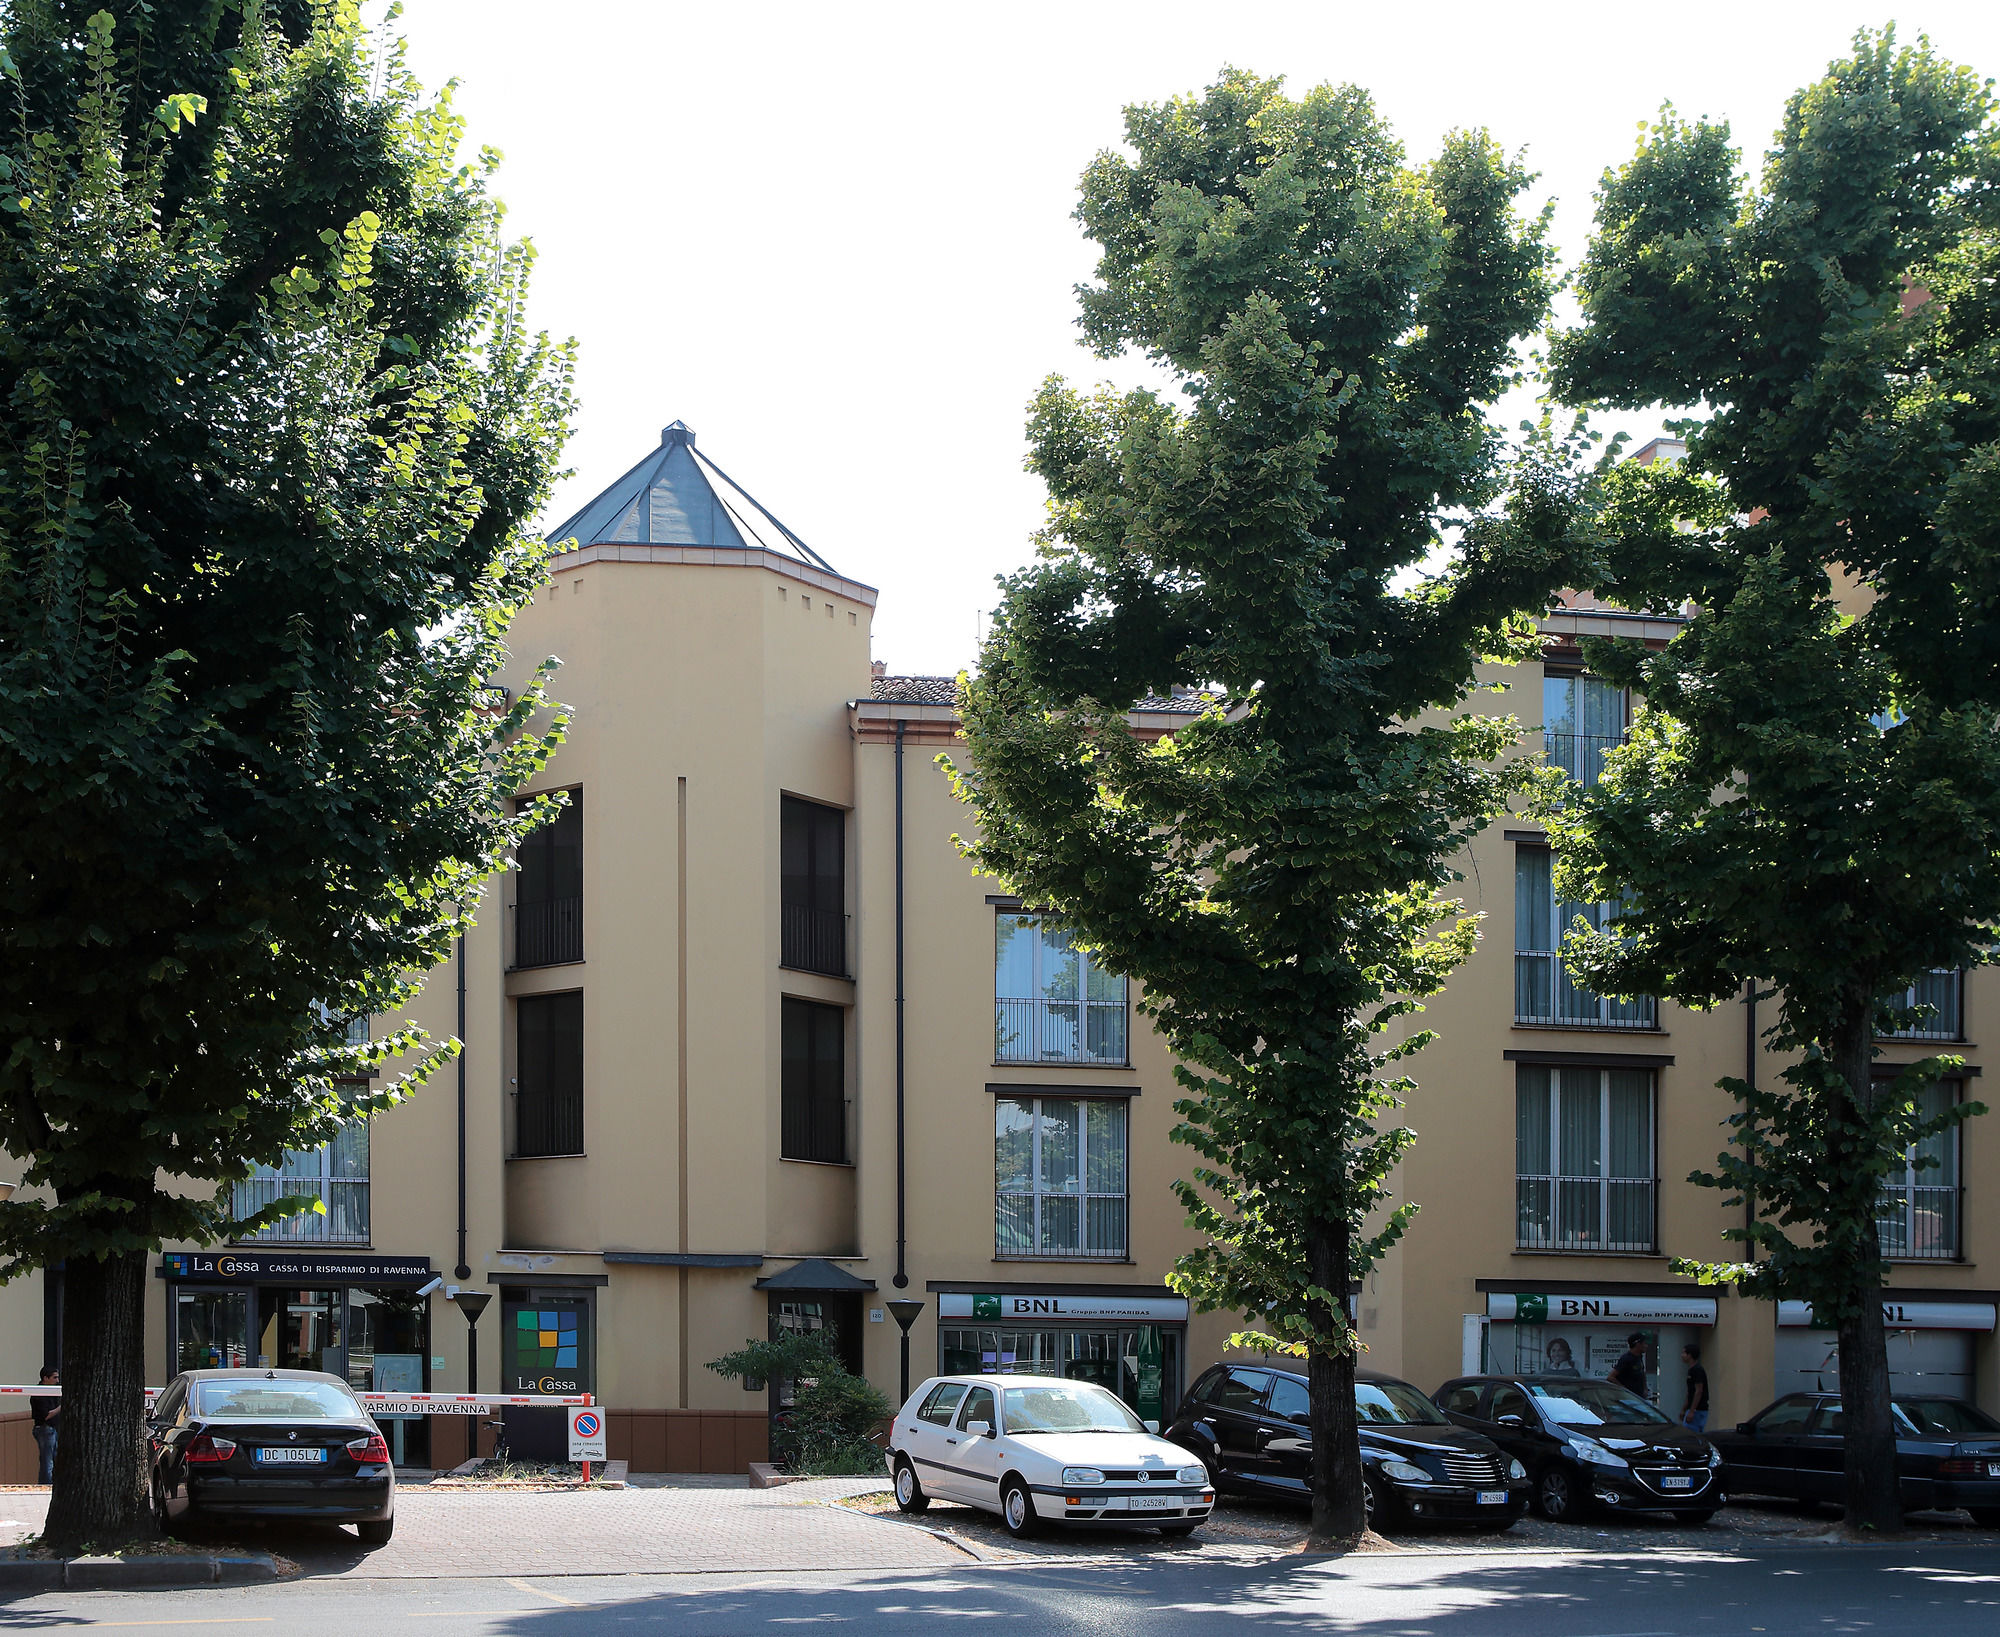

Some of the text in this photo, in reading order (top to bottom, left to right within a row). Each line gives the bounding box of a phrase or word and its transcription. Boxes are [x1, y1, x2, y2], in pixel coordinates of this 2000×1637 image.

[193, 1256, 260, 1277] La Cassa
[269, 1264, 427, 1275] CASSA DI RISPARMIO DI RAVENNA
[1013, 1298, 1067, 1314] BNL
[1560, 1299, 1619, 1317] BNL
[518, 1376, 577, 1394] La Cassa
[412, 1403, 424, 1413] DI
[427, 1404, 487, 1414] RAVENNA
[264, 1449, 320, 1461] DC 105LZ
